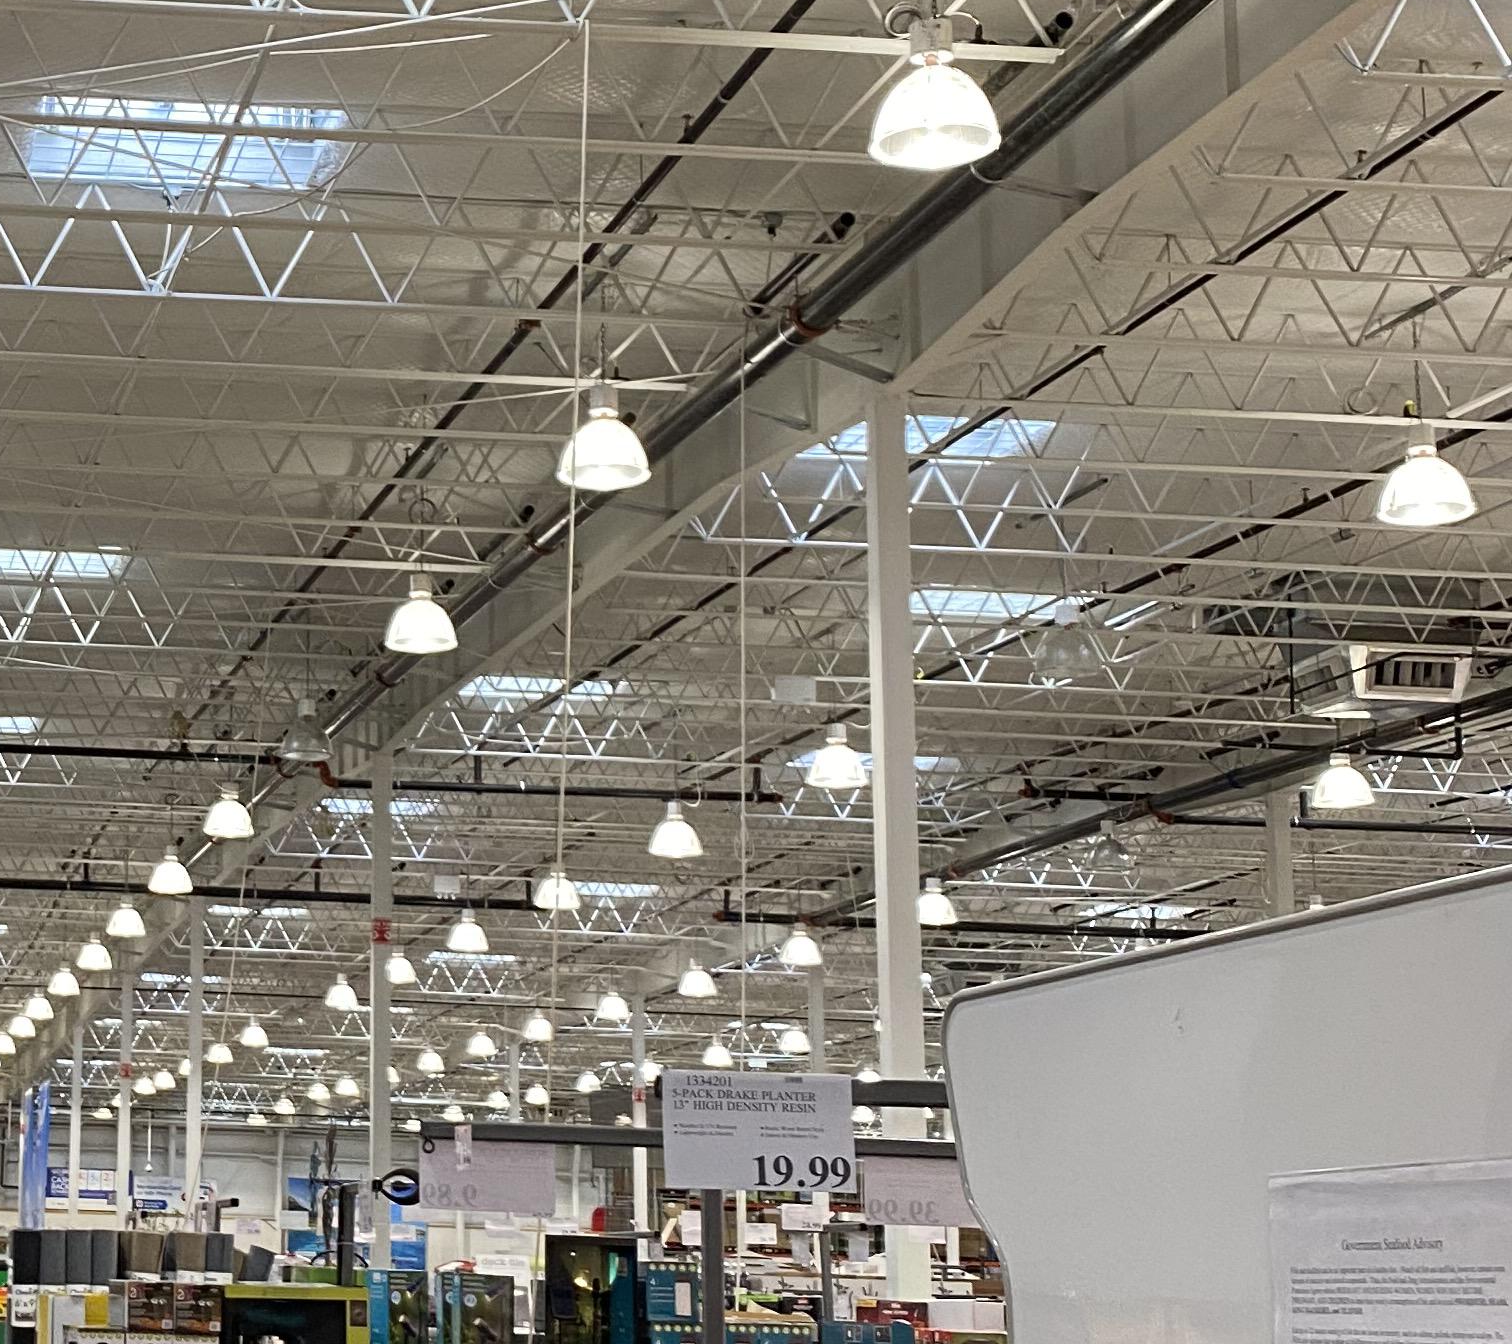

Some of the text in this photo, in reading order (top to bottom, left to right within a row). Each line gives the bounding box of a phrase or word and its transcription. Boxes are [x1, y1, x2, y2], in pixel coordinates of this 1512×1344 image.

[687, 1075, 733, 1087] 1334201
[672, 1088, 816, 1102] 5-PACK DRAKE PLANTER
[693, 1100, 724, 1111] HIGH
[727, 1101, 778, 1113] DENSITY
[781, 1103, 816, 1113] RESIN
[753, 1154, 851, 1189] 19.99
